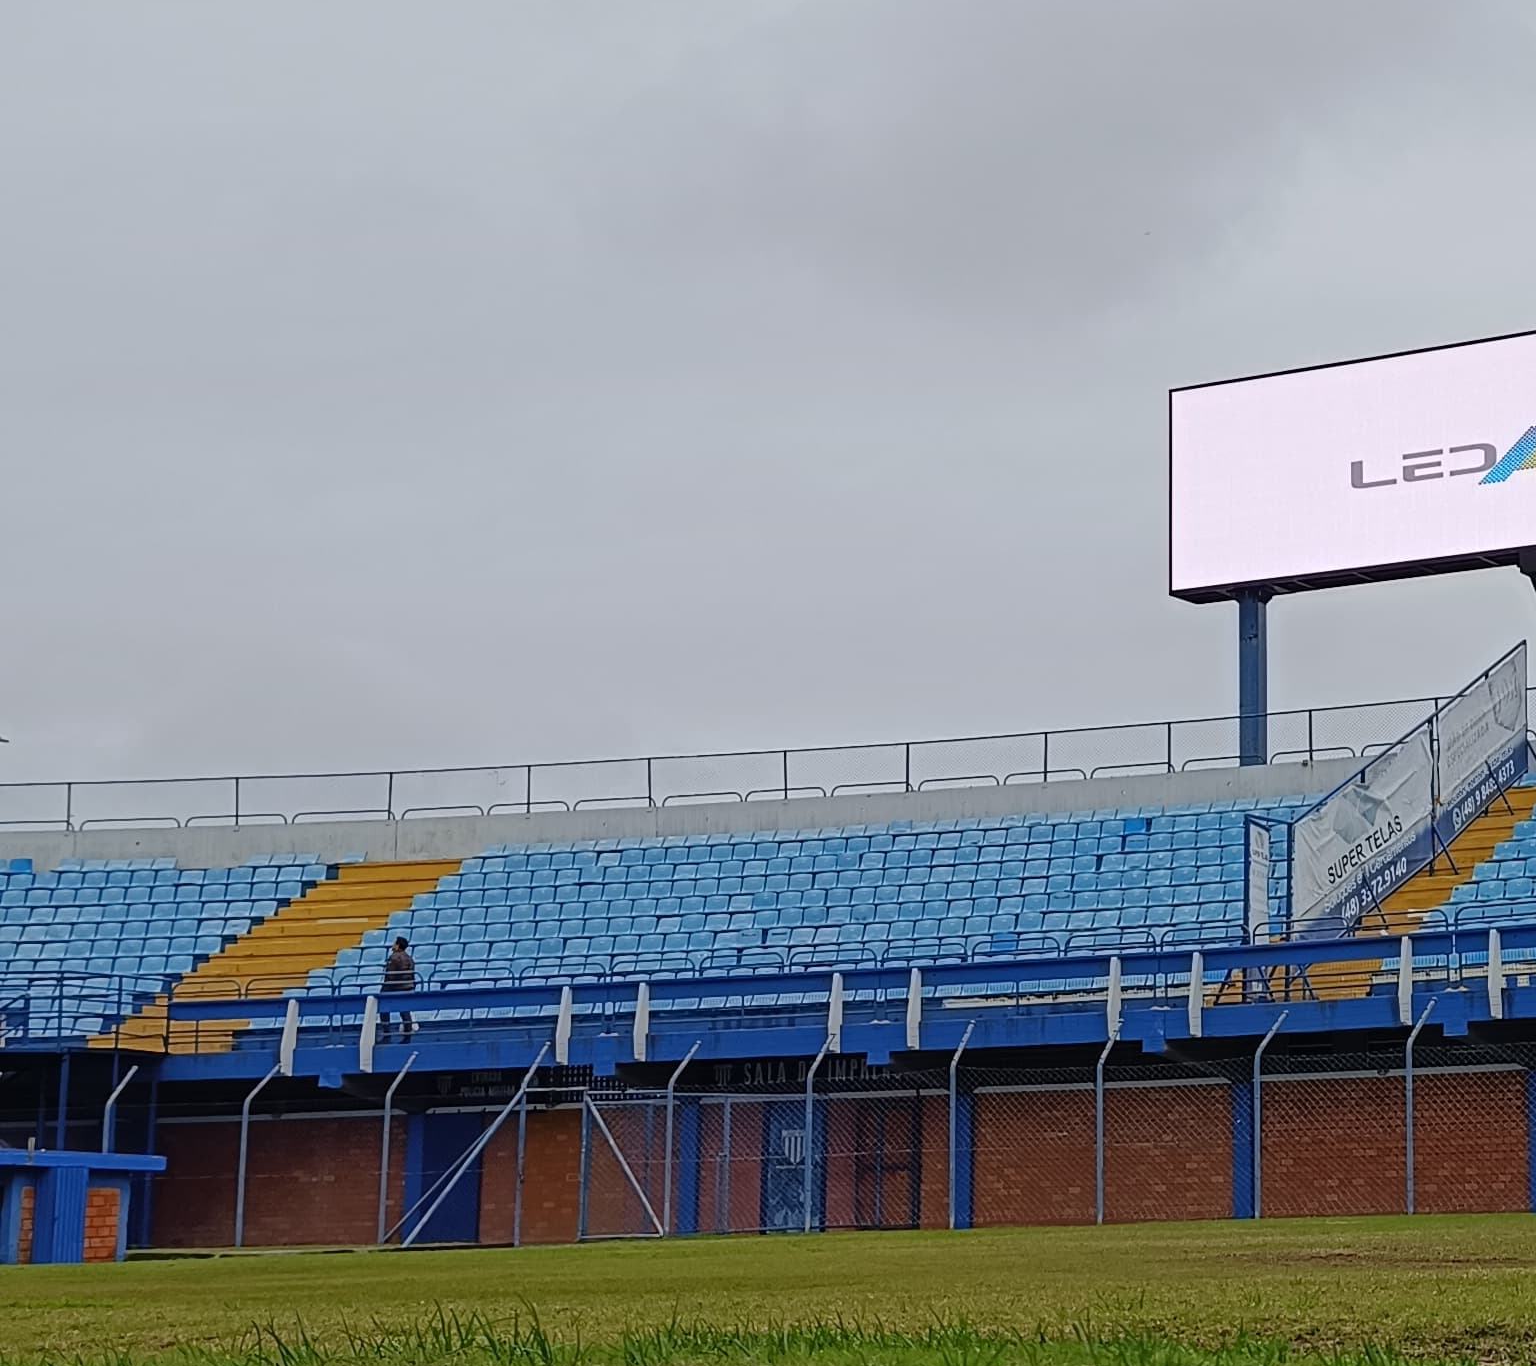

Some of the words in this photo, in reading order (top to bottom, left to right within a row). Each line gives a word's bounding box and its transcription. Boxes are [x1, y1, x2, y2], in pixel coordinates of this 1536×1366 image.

[1351, 443, 1497, 490] LED
[1327, 843, 1367, 884] SUPER
[1365, 815, 1403, 854] TELAS
[743, 1061, 786, 1085] SALA
[798, 1060, 813, 1082] D
